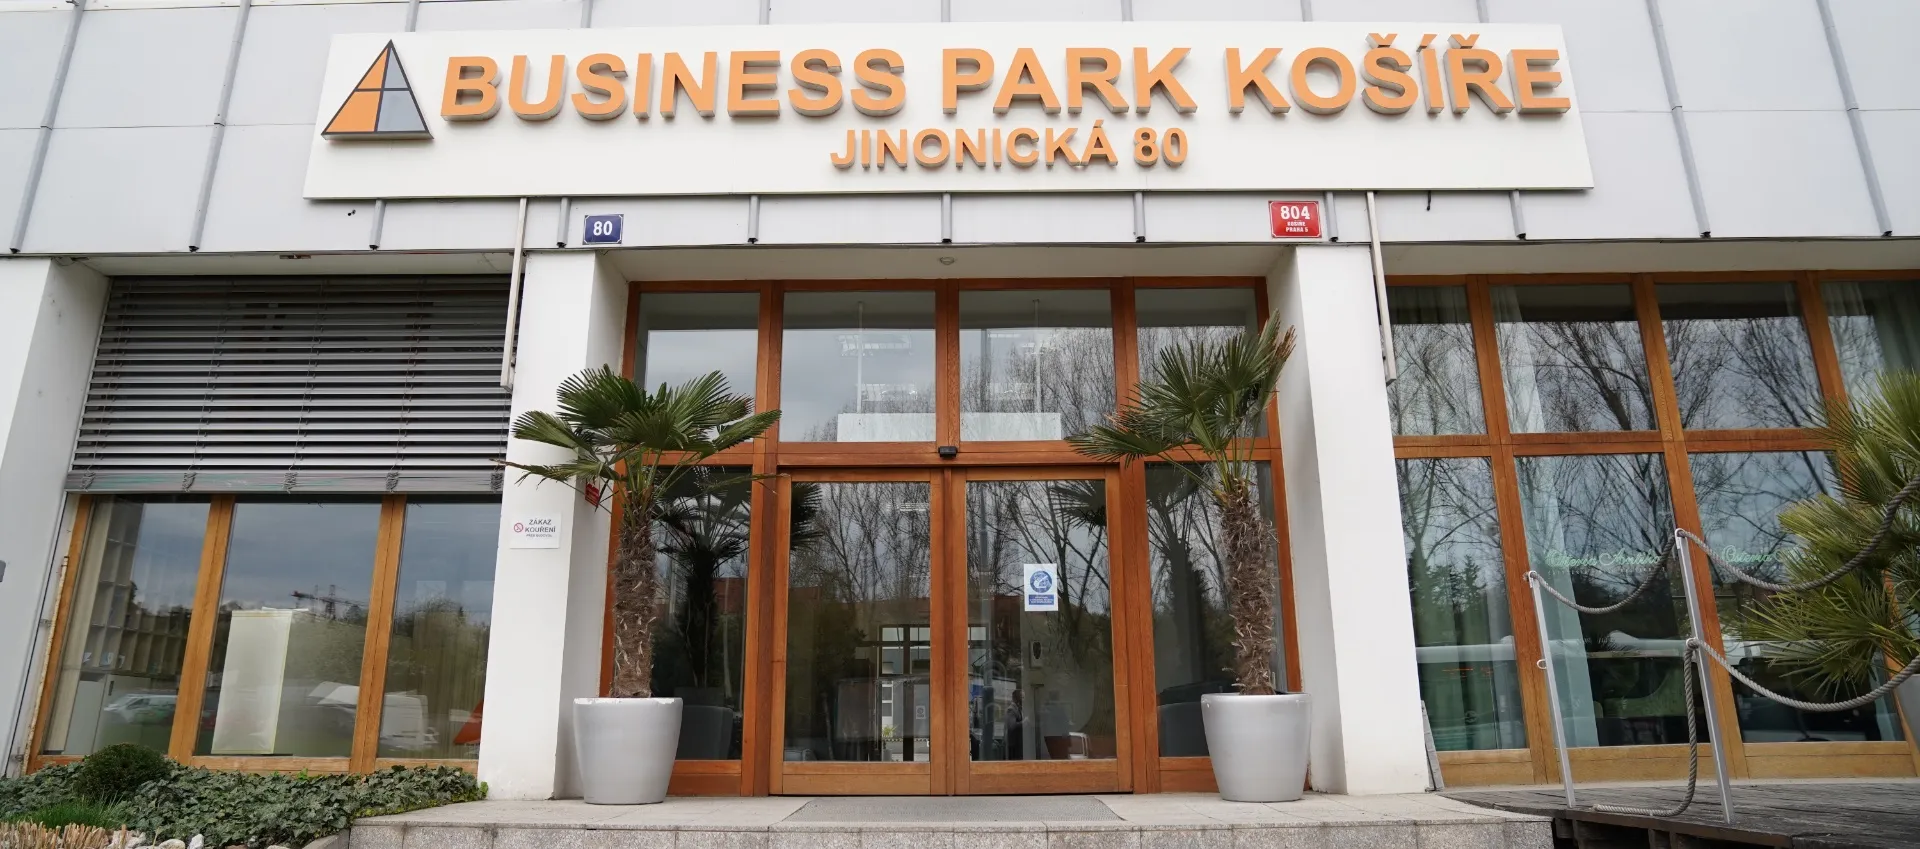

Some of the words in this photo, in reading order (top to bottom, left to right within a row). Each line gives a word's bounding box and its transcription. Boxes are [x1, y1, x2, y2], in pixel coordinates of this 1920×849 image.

[441, 49, 905, 121] BUSINESS
[943, 47, 1198, 115] PARK
[1224, 33, 1572, 116] KOŠÍŘE
[830, 119, 1119, 169] JINONICKÁ
[1133, 127, 1189, 167] 80
[593, 220, 613, 236] 80
[1280, 205, 1311, 219] 804
